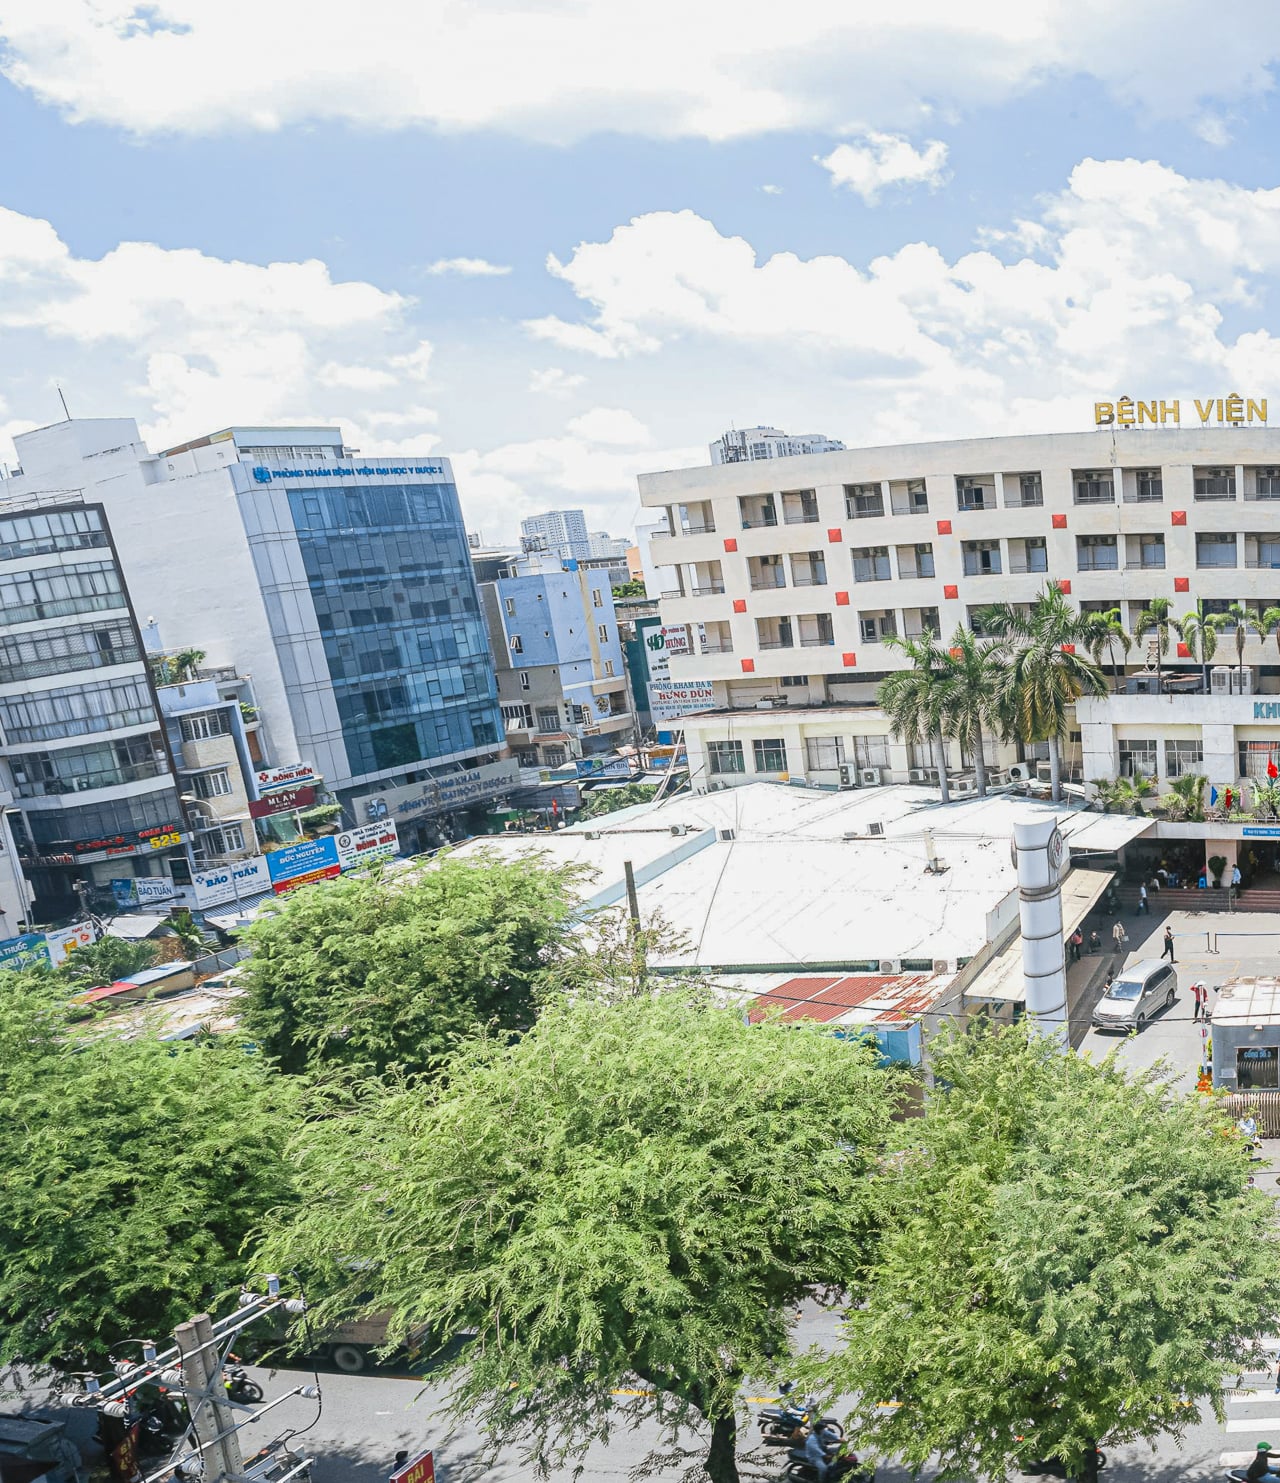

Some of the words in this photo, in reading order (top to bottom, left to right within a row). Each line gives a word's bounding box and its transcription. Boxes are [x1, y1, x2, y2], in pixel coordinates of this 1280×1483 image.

[1094, 395, 1180, 429] BỆNH
[1194, 392, 1267, 427] VIỆN
[272, 467, 304, 478] PHÒNG
[150, 831, 181, 849] 525
[206, 875, 229, 888] BẢO
[4, 941, 28, 956] THUỐC
